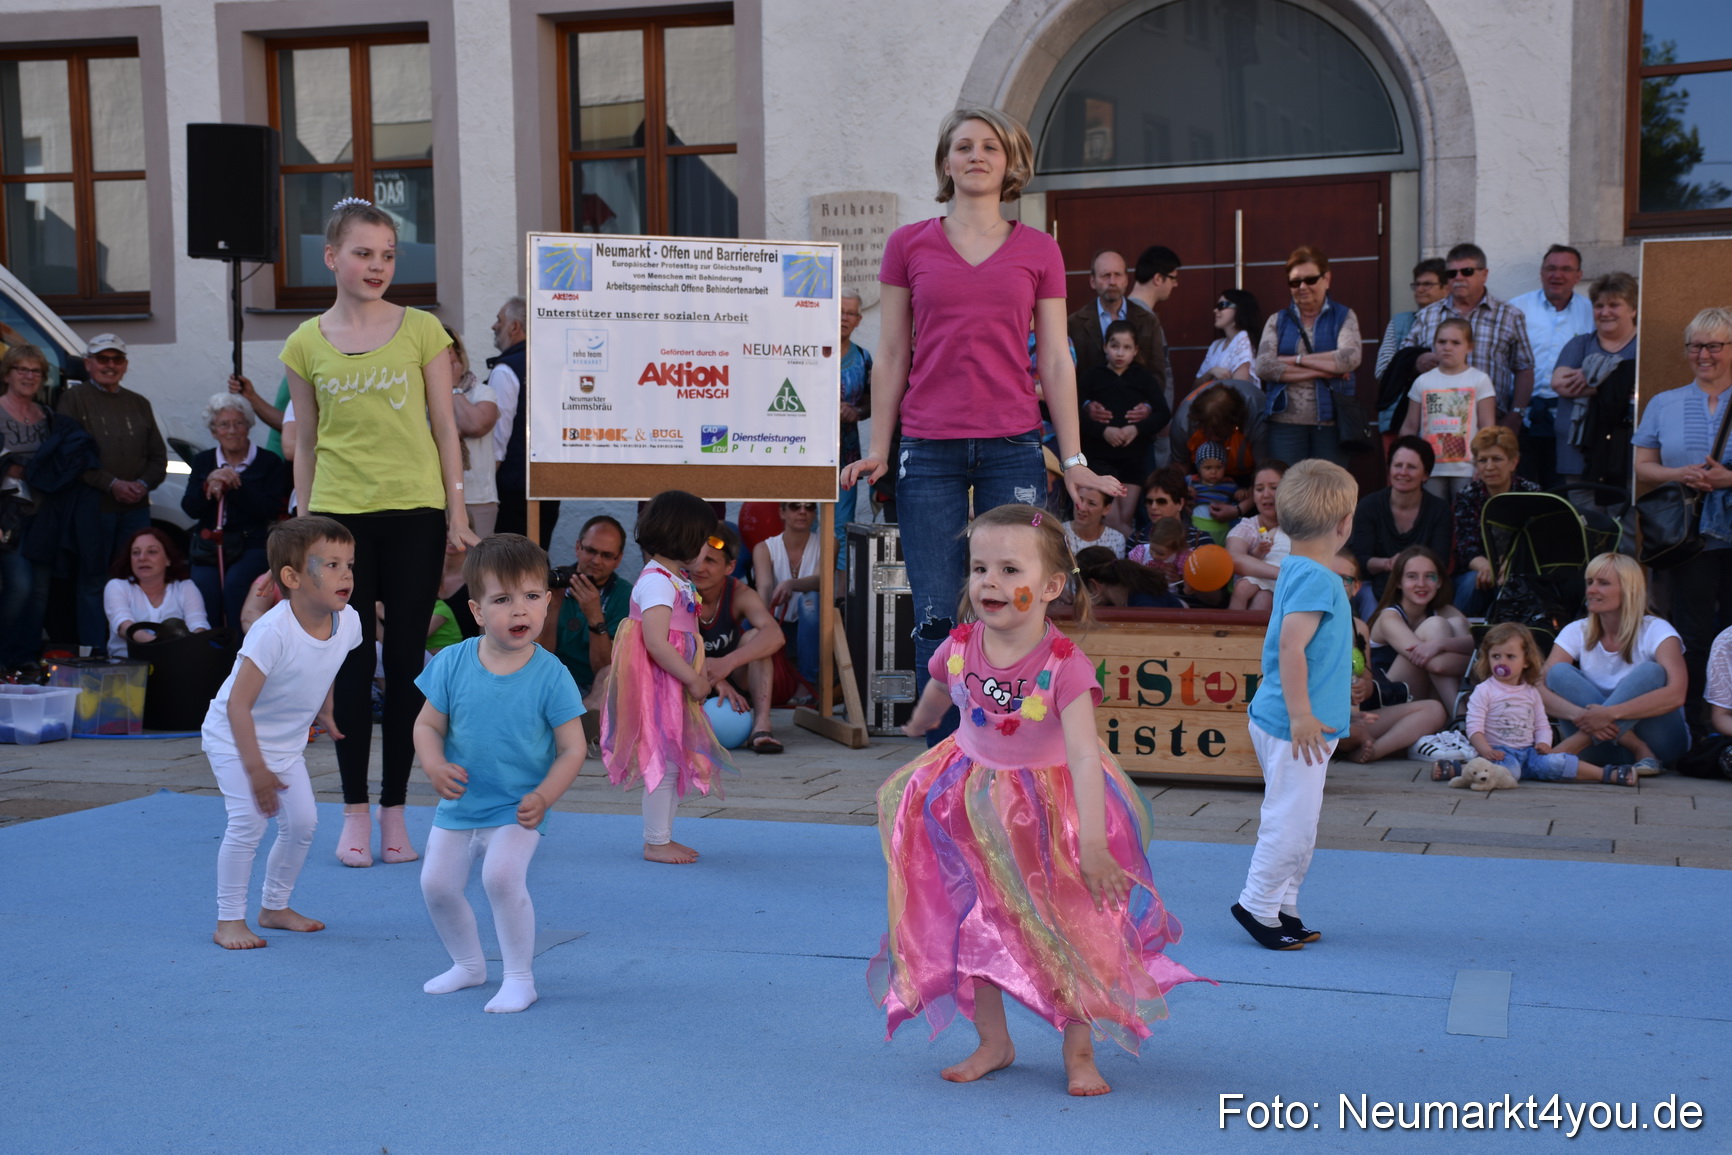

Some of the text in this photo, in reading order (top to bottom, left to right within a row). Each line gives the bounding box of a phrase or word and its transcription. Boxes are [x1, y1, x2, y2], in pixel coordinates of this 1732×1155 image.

[596, 243, 651, 259] Neumarkt
[661, 245, 690, 260] Offen
[694, 247, 713, 260] und
[716, 247, 778, 263] Barrierefrei
[612, 260, 659, 269] Europäischer
[661, 262, 698, 271] Protesttag
[713, 263, 763, 273] Gleichstellung
[699, 274, 743, 284] Behinderung
[606, 281, 769, 295] Arbeitsgemeinschaft Offene Behindertenarbeit
[537, 308, 749, 322] Unterstützer unserer sozialen Arbeit
[573, 349, 586, 358] reha
[661, 348, 695, 356] Gefördert
[743, 343, 818, 358] NEUMARKT
[677, 388, 729, 399] MENSCH
[562, 402, 612, 411] Lammsbräu
[635, 428, 646, 442] &
[702, 426, 718, 434] CAD
[732, 432, 806, 445] Dienstleistungen
[1106, 718, 1226, 758] iste
